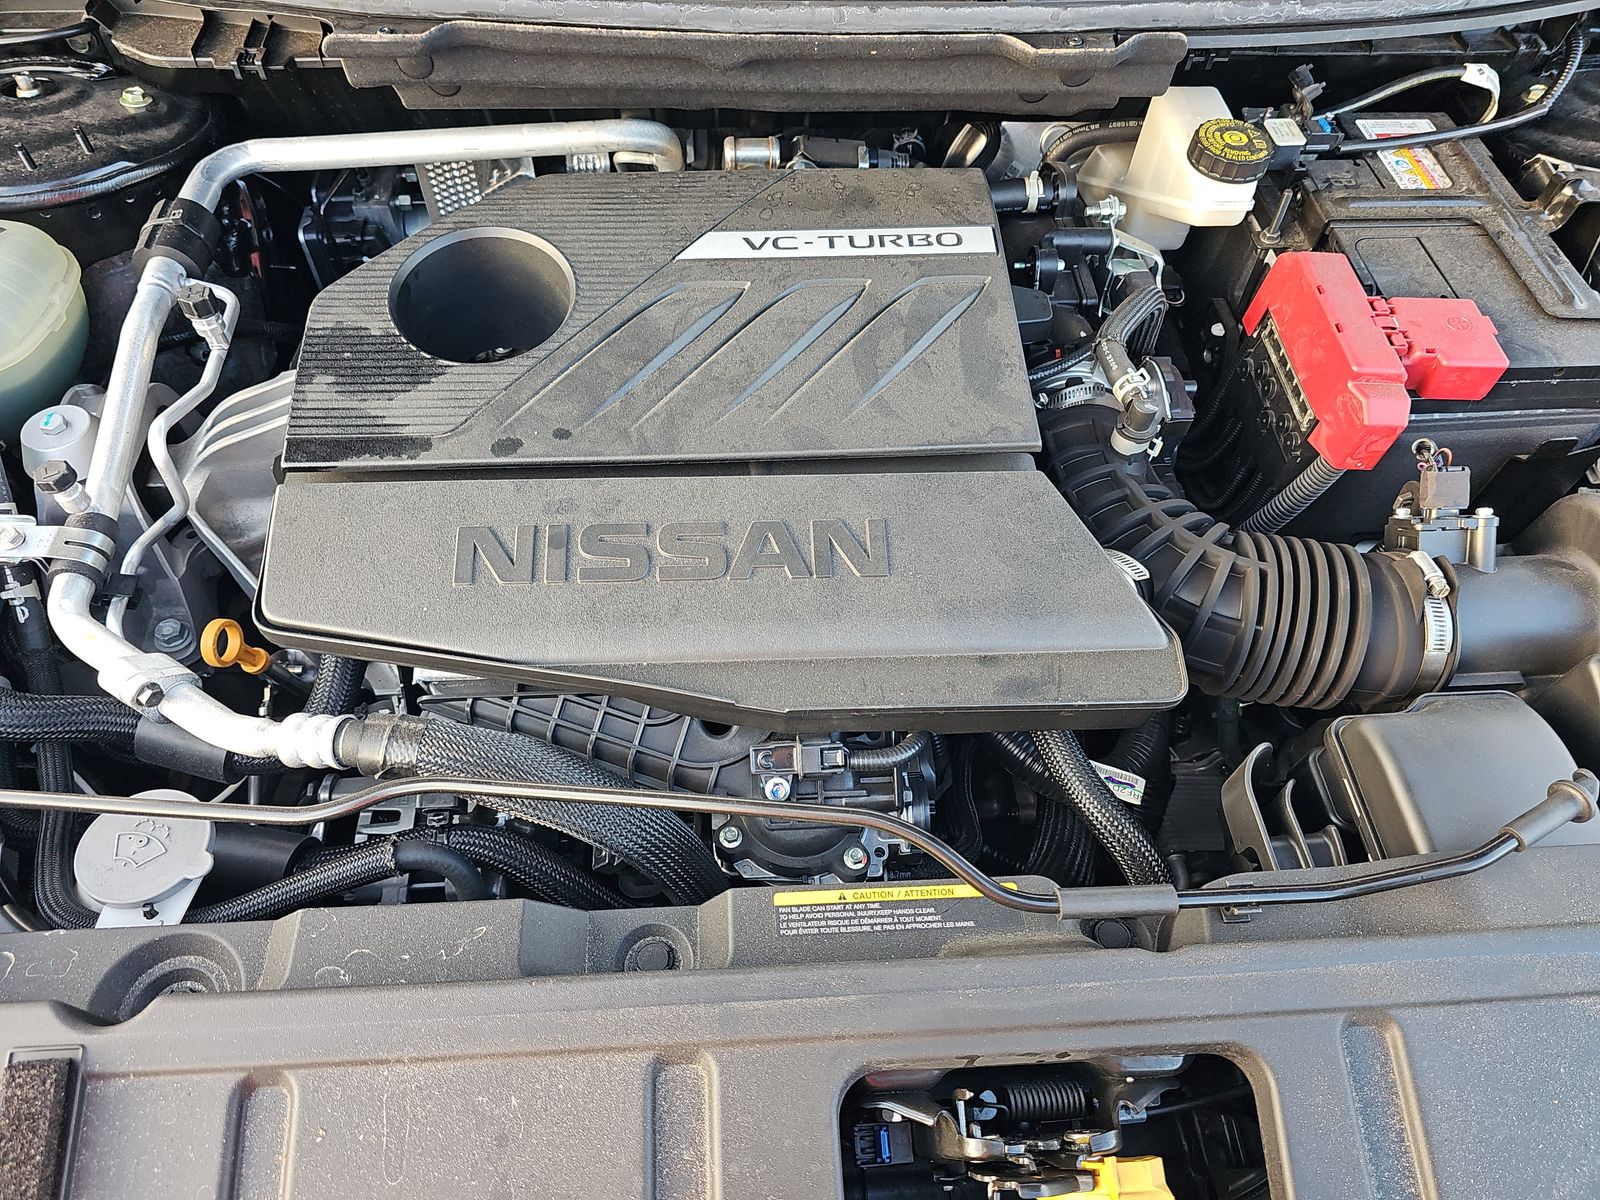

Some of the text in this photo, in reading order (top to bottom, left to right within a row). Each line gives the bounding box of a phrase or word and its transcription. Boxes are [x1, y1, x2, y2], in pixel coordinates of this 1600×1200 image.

[742, 232, 964, 250] VC-TURBO
[453, 518, 889, 586] NISSAN
[853, 891, 894, 900] CAUTION
[904, 888, 954, 898] ATTENTION
[786, 921, 826, 929] VENTILATEUR
[860, 917, 893, 925] DÉMARRER
[798, 927, 820, 935] ÉVITER
[905, 922, 942, 930] APPROCHER
